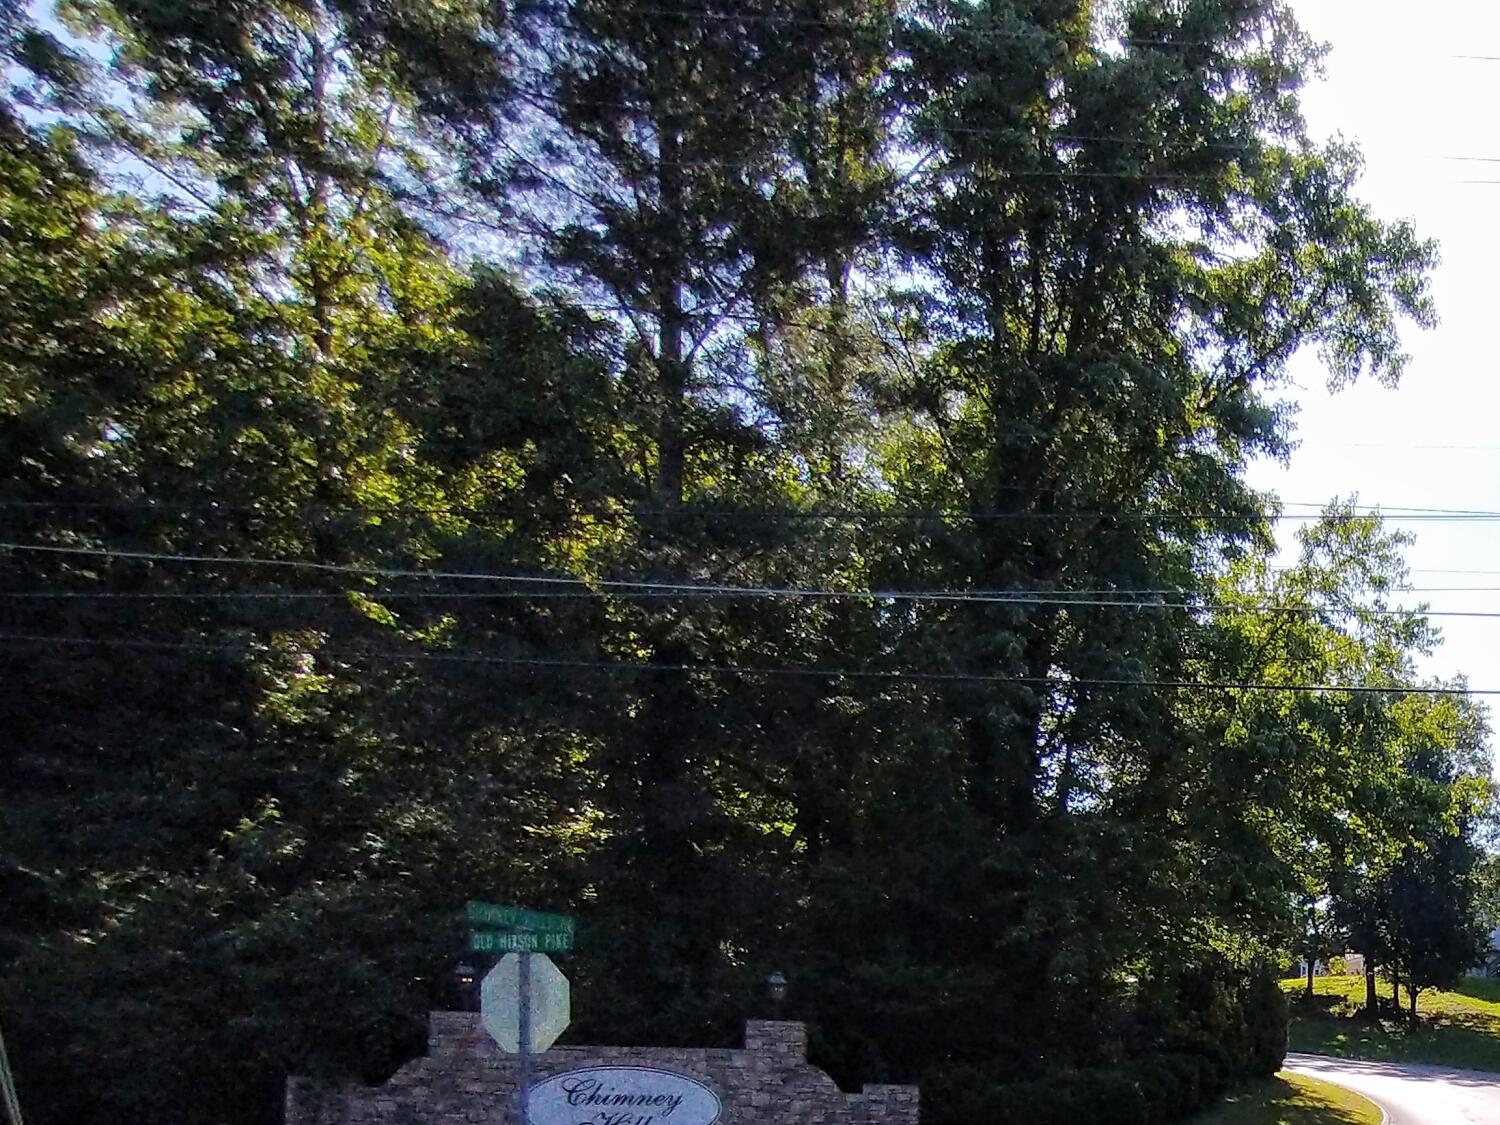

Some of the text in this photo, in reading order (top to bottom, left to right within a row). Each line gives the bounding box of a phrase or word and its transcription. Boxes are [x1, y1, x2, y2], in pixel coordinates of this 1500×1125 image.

[473, 934, 493, 949] OLD
[545, 934, 568, 949] PIKE
[562, 1077, 683, 1116] Chimney
